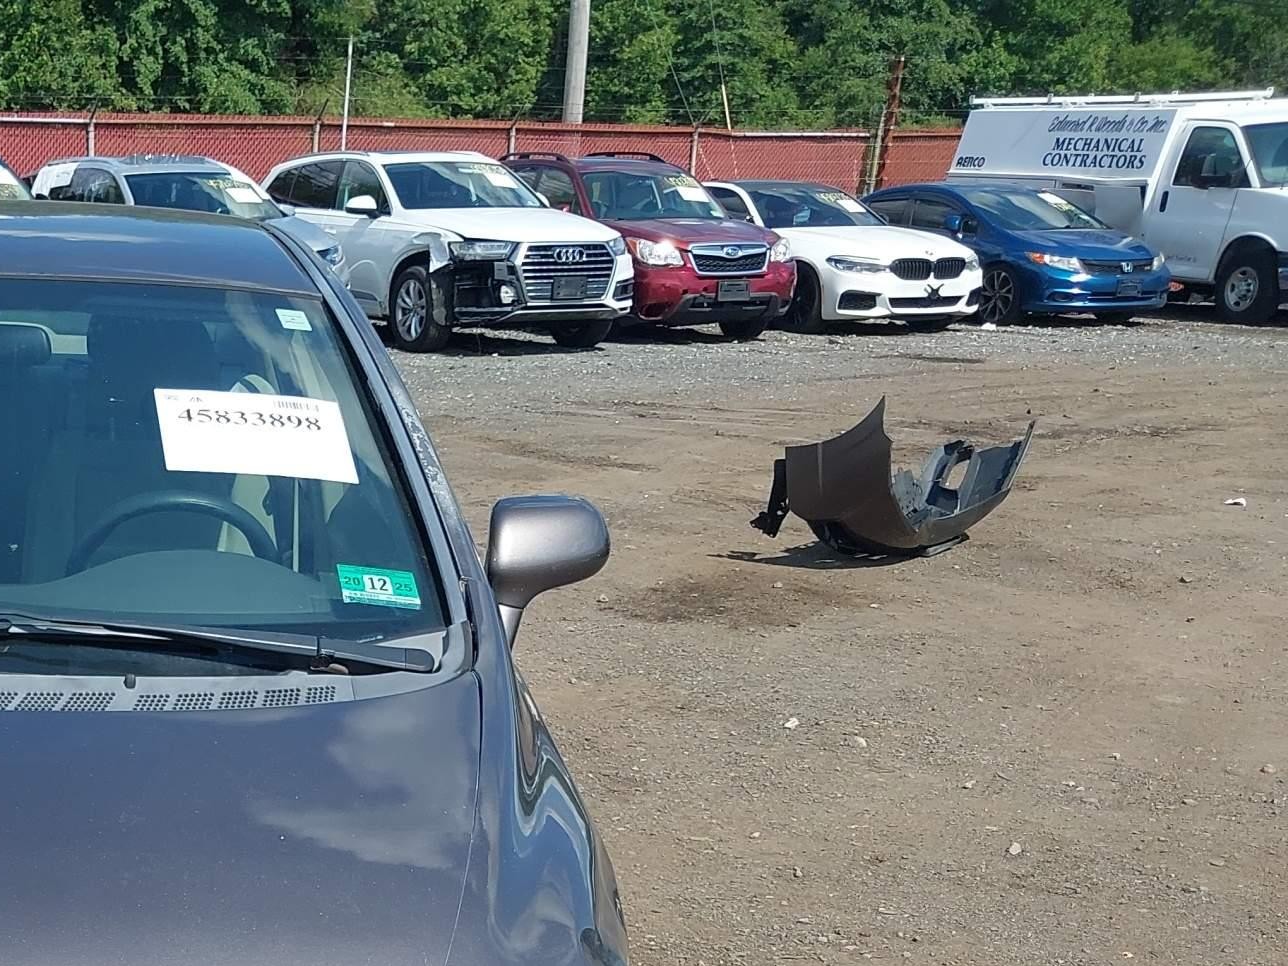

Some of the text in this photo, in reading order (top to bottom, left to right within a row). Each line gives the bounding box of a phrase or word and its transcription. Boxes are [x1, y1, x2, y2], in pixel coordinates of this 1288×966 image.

[1052, 136, 1145, 153] MECHANICAL
[1042, 152, 1147, 170] CONTRACTORS
[177, 407, 323, 432] 45833898
[343, 576, 412, 593] 20 12 25
